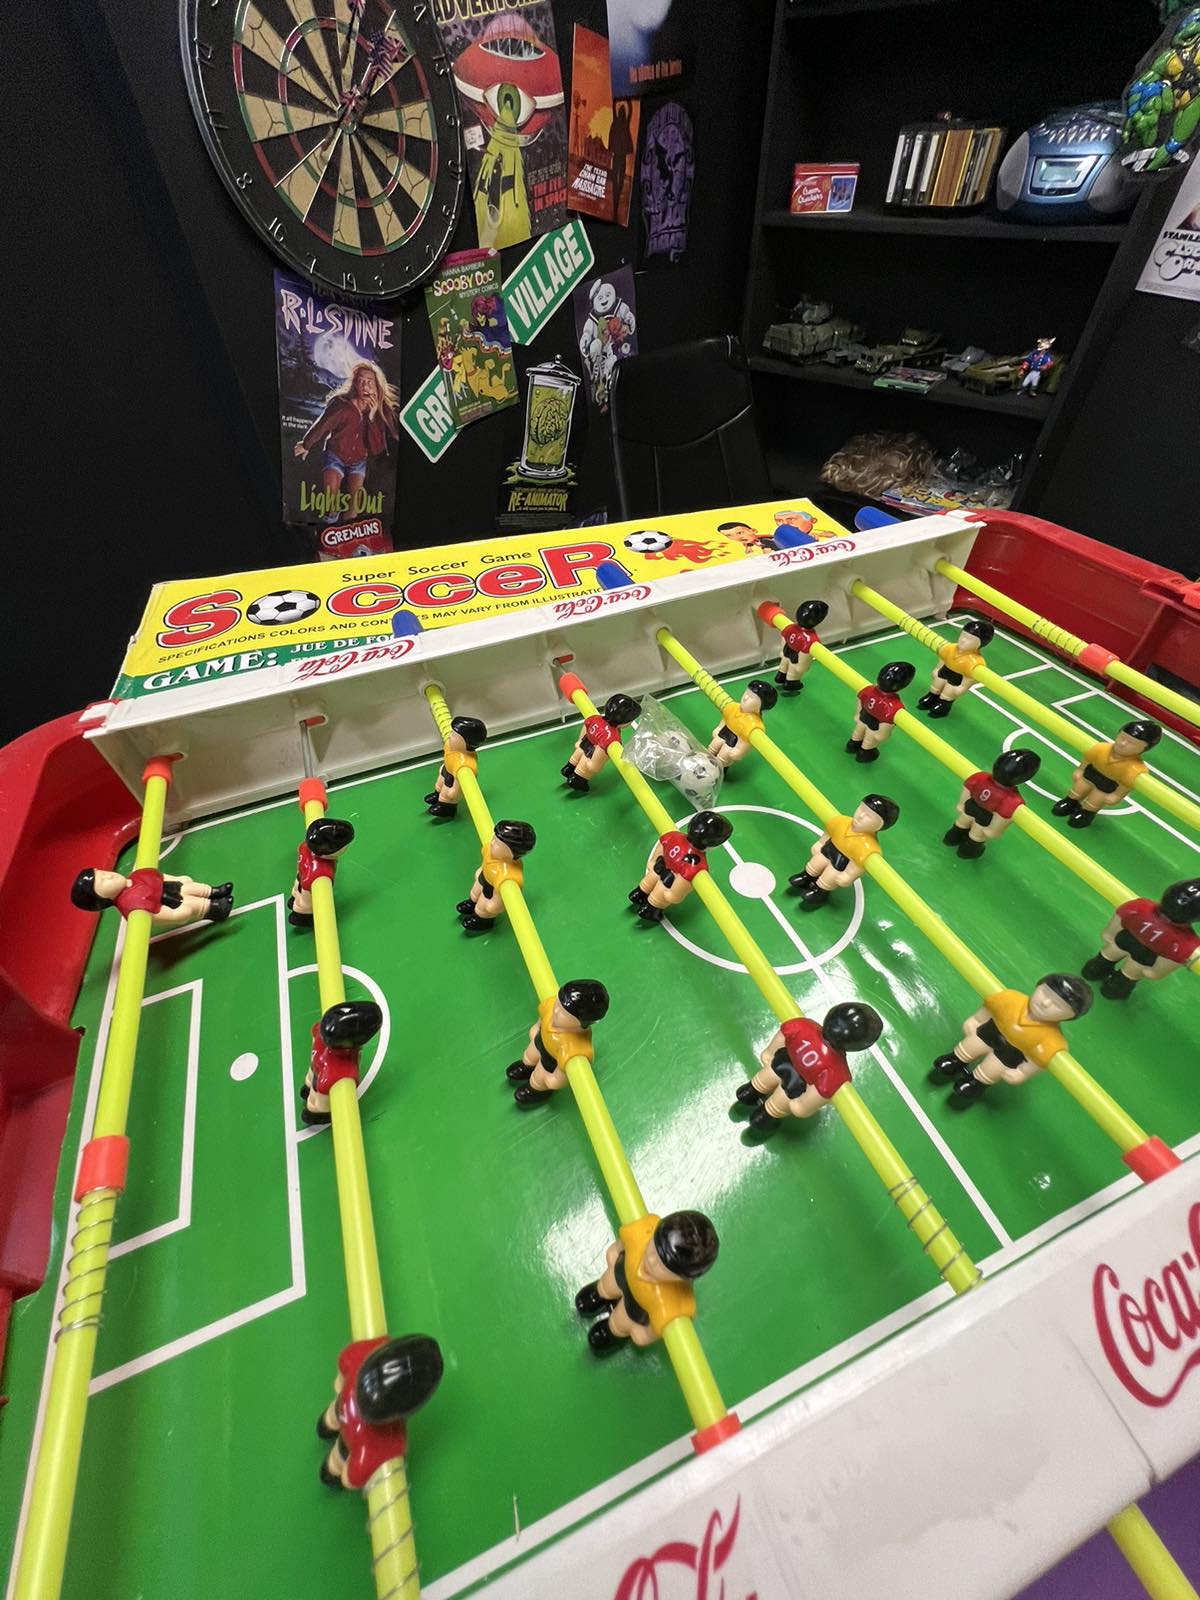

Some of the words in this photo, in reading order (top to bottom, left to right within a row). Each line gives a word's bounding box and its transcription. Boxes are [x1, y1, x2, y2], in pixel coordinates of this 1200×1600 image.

[571, 177, 606, 198] MASSACRE
[433, 273, 474, 296] SCOOBY
[507, 222, 585, 329] VILLAGE
[299, 480, 351, 519] Lights
[353, 486, 385, 514] Out
[507, 491, 568, 512] RE-ANIMATOR
[342, 569, 397, 583] Super
[408, 559, 469, 575] Soccer
[480, 550, 532, 564] Game
[158, 632, 266, 664] SPECIFICATIONS
[269, 624, 326, 638] COLORS
[330, 622, 357, 631] AND
[432, 610, 457, 619] MAY
[461, 605, 493, 615] VARY
[496, 599, 530, 609] FROM
[788, 632, 796, 643] 6
[142, 650, 279, 691] GAME:
[290, 641, 323, 653] JUE
[333, 637, 361, 648] DE
[979, 788, 991, 802] 9
[669, 845, 681, 860] 8
[1138, 920, 1164, 943] 11
[794, 1038, 819, 1067] 10
